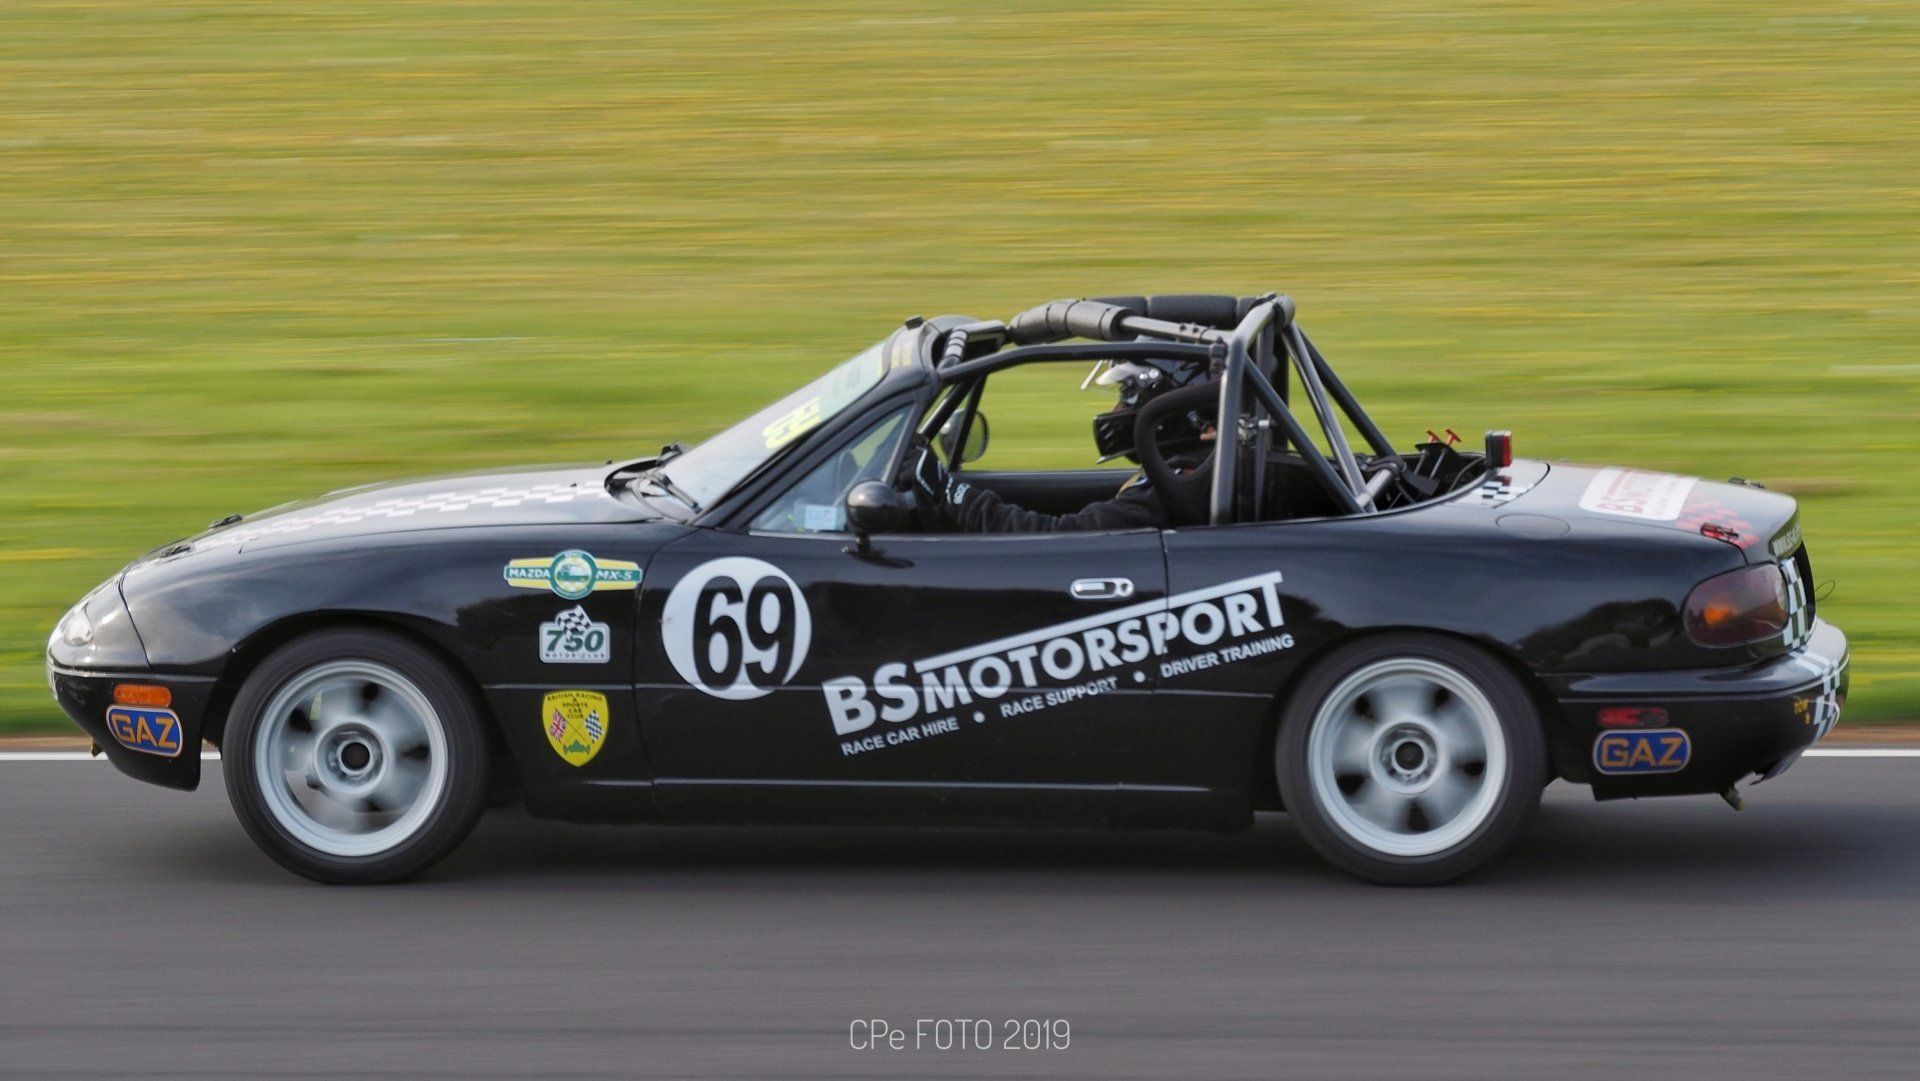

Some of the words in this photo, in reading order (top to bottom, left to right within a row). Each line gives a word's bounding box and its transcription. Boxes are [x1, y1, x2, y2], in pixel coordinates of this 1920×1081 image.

[508, 567, 551, 580] MAZDA
[595, 569, 634, 581] MX-5
[546, 630, 605, 652] 750
[692, 575, 796, 691] 69
[1160, 653, 1220, 679] DRIVER
[1220, 633, 1295, 660] TRAINING
[1000, 694, 1045, 718] RACE
[1046, 676, 1119, 708] SUPPORT
[111, 713, 177, 748] GAZ
[840, 734, 886, 757] RACE
[886, 727, 921, 747] CAR
[920, 716, 960, 738] HIRE
[1602, 737, 1683, 767] GAZ
